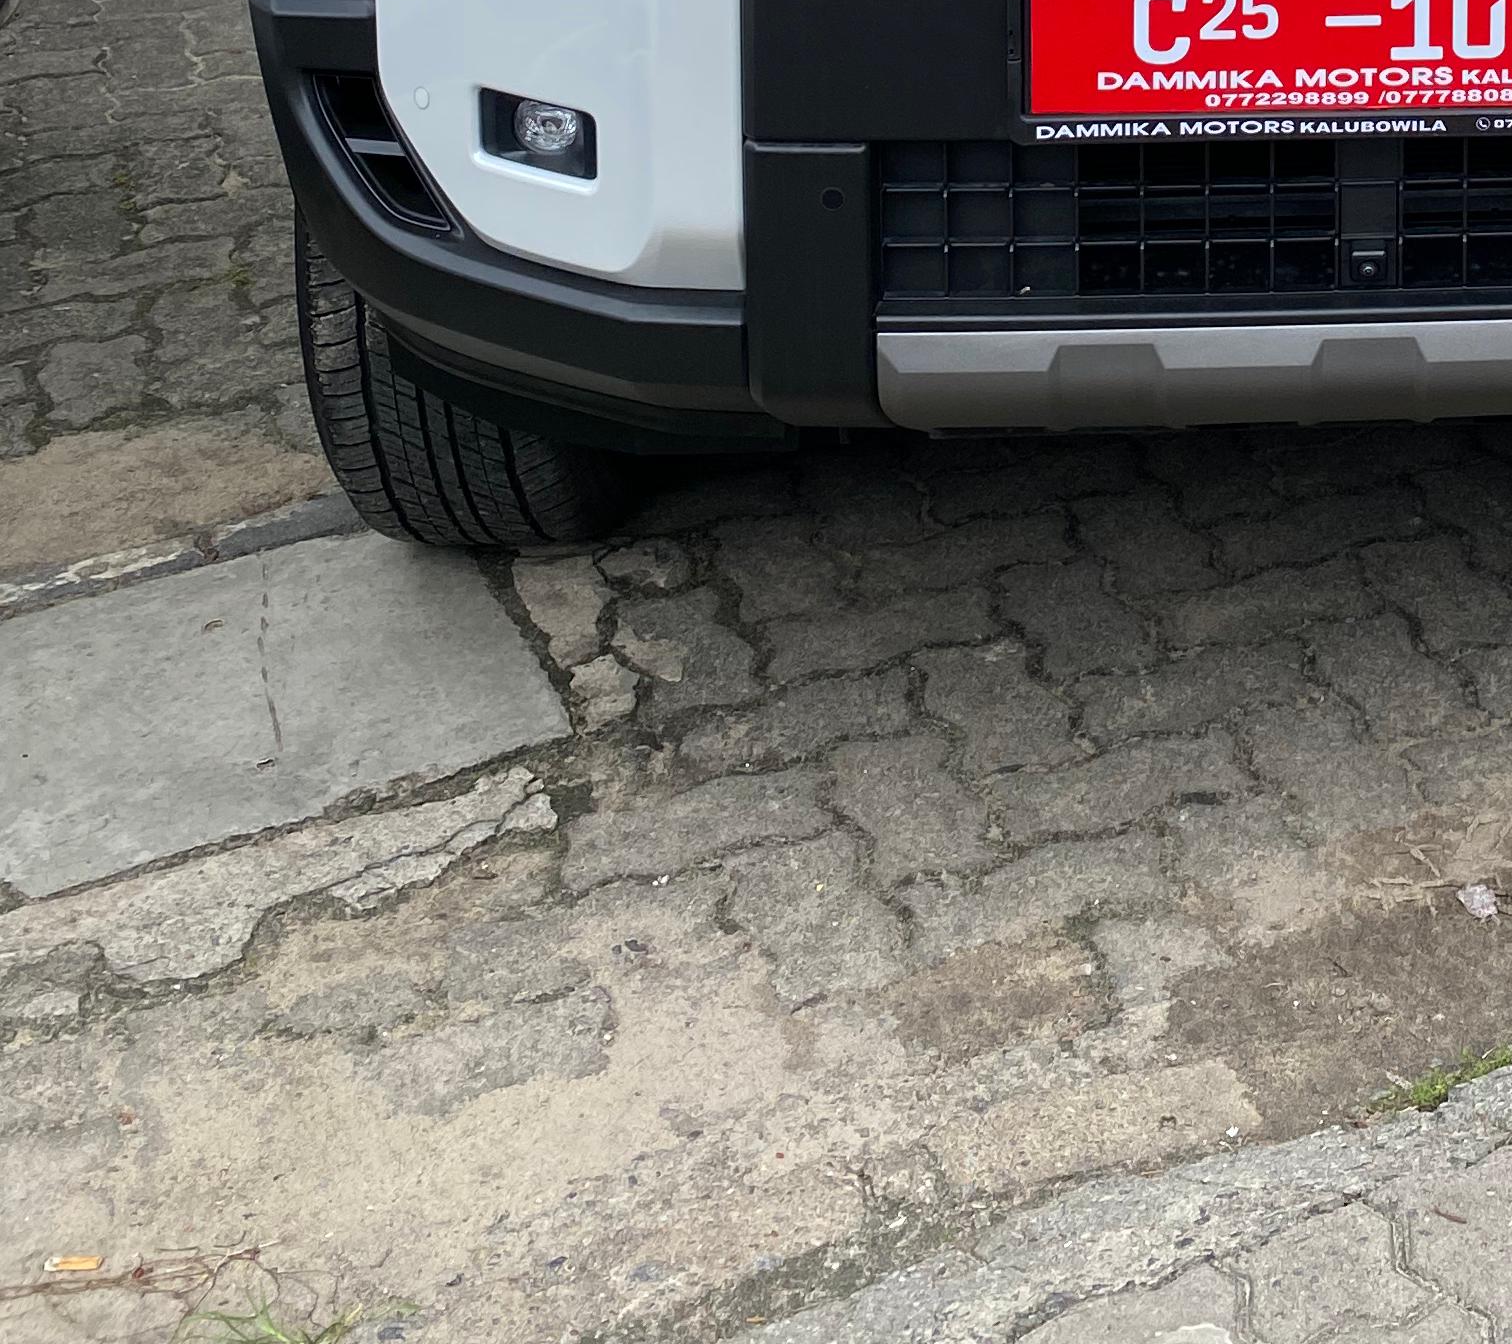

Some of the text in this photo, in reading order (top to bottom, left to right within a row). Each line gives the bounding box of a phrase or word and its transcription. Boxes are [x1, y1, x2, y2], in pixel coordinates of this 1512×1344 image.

[1097, 69, 1284, 91] DAMMIKA
[1295, 66, 1454, 88] MOTORS
[1205, 90, 1370, 107] 0772298899
[1035, 121, 1172, 140] DAMMIKA
[1180, 120, 1295, 136] MOTORS
[1300, 119, 1447, 133] KALUBOWILA
